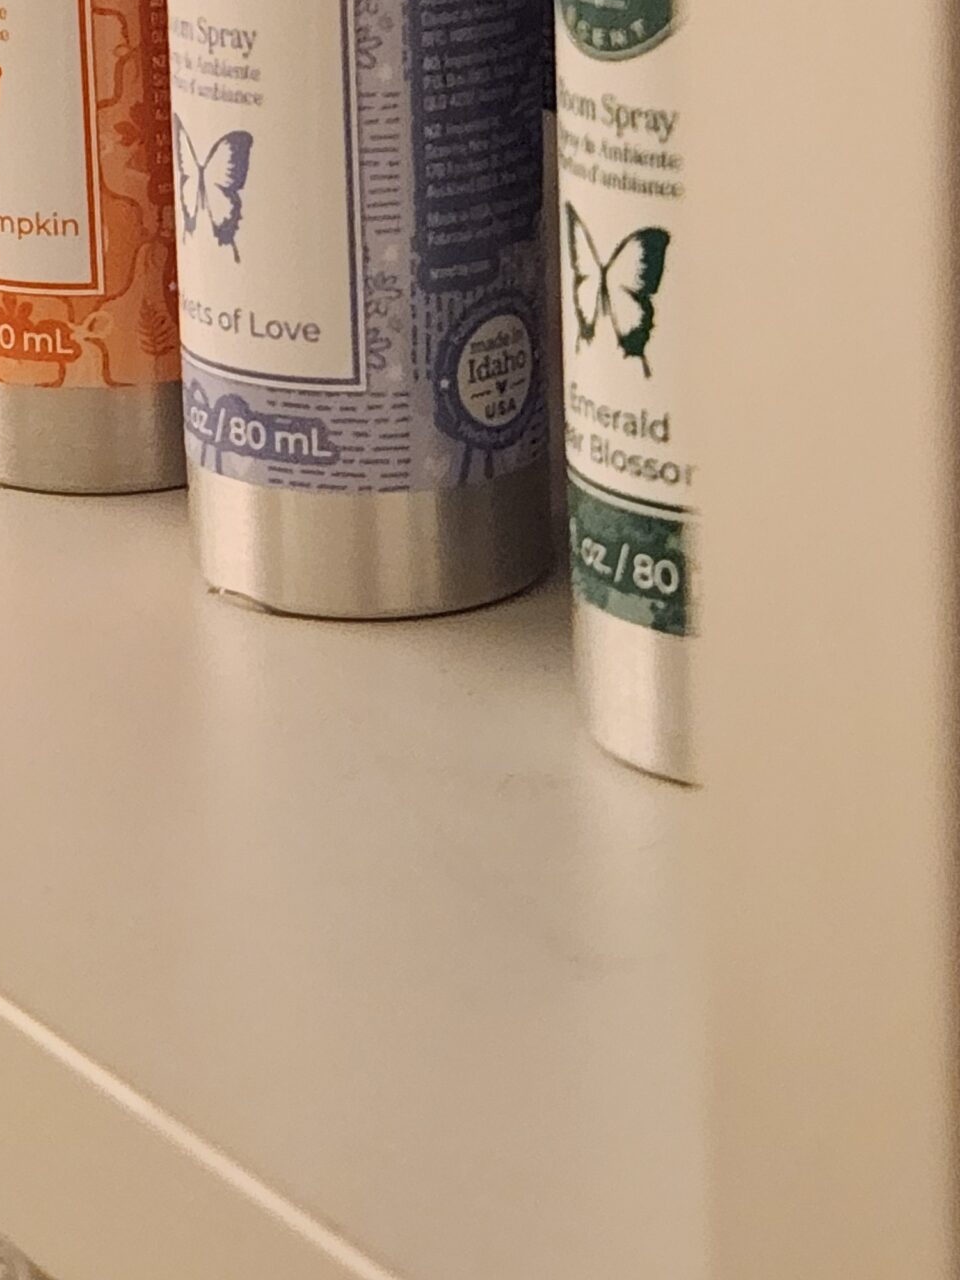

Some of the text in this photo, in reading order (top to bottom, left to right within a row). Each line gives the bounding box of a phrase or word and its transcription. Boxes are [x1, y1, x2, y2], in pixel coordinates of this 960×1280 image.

[196, 16, 257, 60] Spray
[601, 92, 680, 145] Spray
[23, 327, 75, 354] mL
[218, 307, 242, 335] of
[249, 310, 321, 343] Love
[467, 348, 528, 384] Idaho
[484, 397, 517, 420] USA
[569, 381, 670, 444] Emerald
[274, 427, 334, 457] mL
